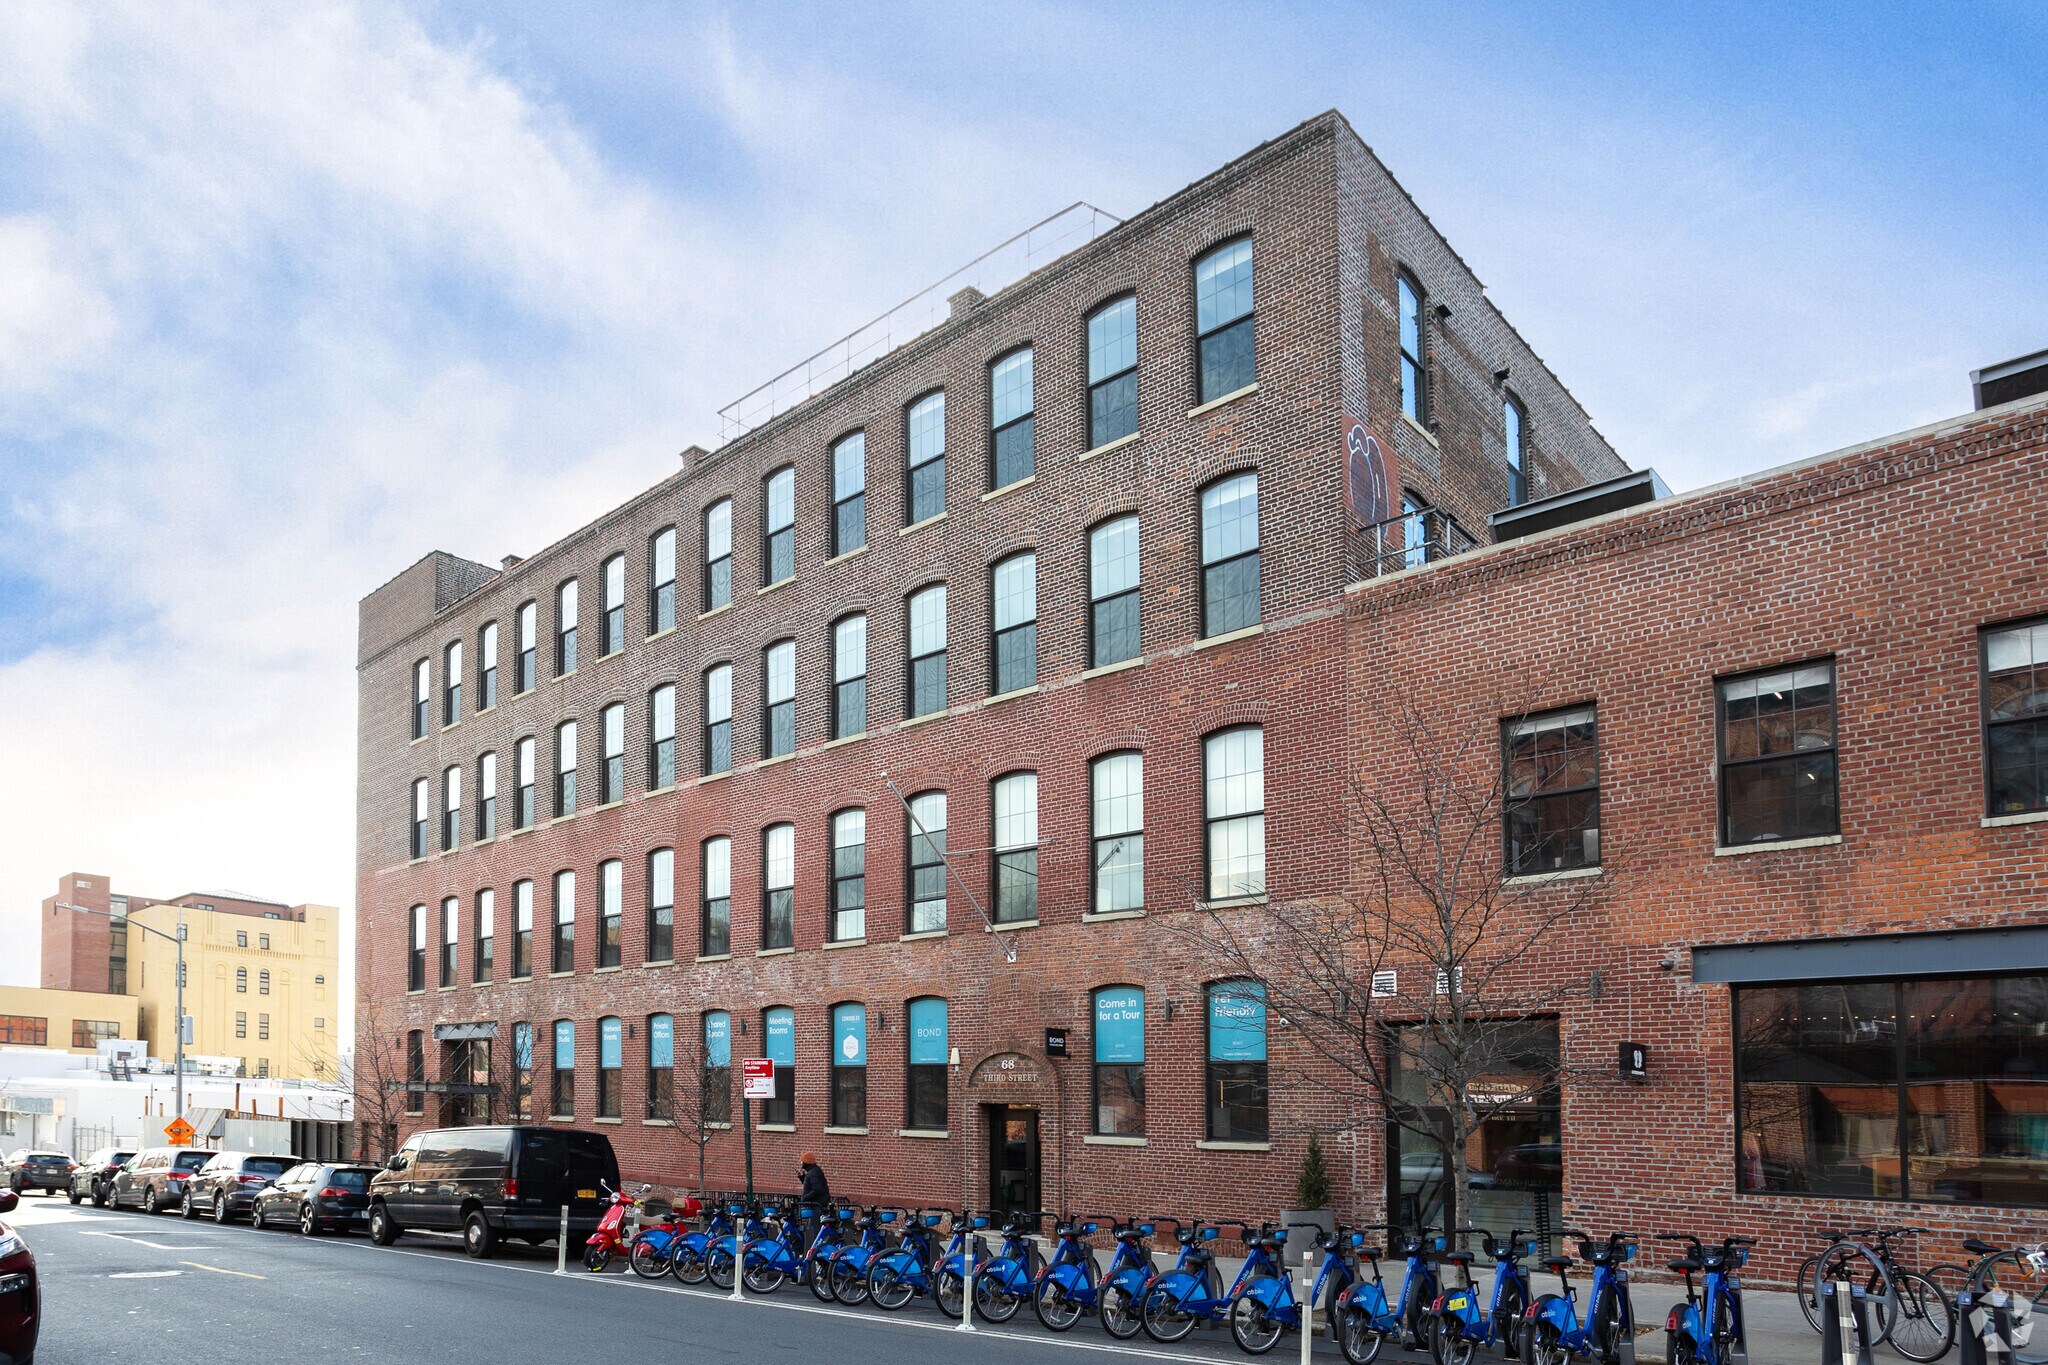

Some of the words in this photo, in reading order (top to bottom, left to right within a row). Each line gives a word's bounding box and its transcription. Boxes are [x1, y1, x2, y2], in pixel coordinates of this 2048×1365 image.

[1098, 999, 1126, 1009] Come
[1128, 997, 1137, 1007] in
[1099, 1011, 1111, 1021] for
[1113, 1012, 1120, 1020] a
[1122, 1010, 1141, 1020] Tour
[769, 1016, 793, 1026] Meeting
[769, 1027, 788, 1035] Rooms
[917, 1027, 942, 1038] BOND
[1001, 1060, 1015, 1070] 68
[983, 1073, 1006, 1082] THIRD
[1008, 1073, 1038, 1082] STREET
